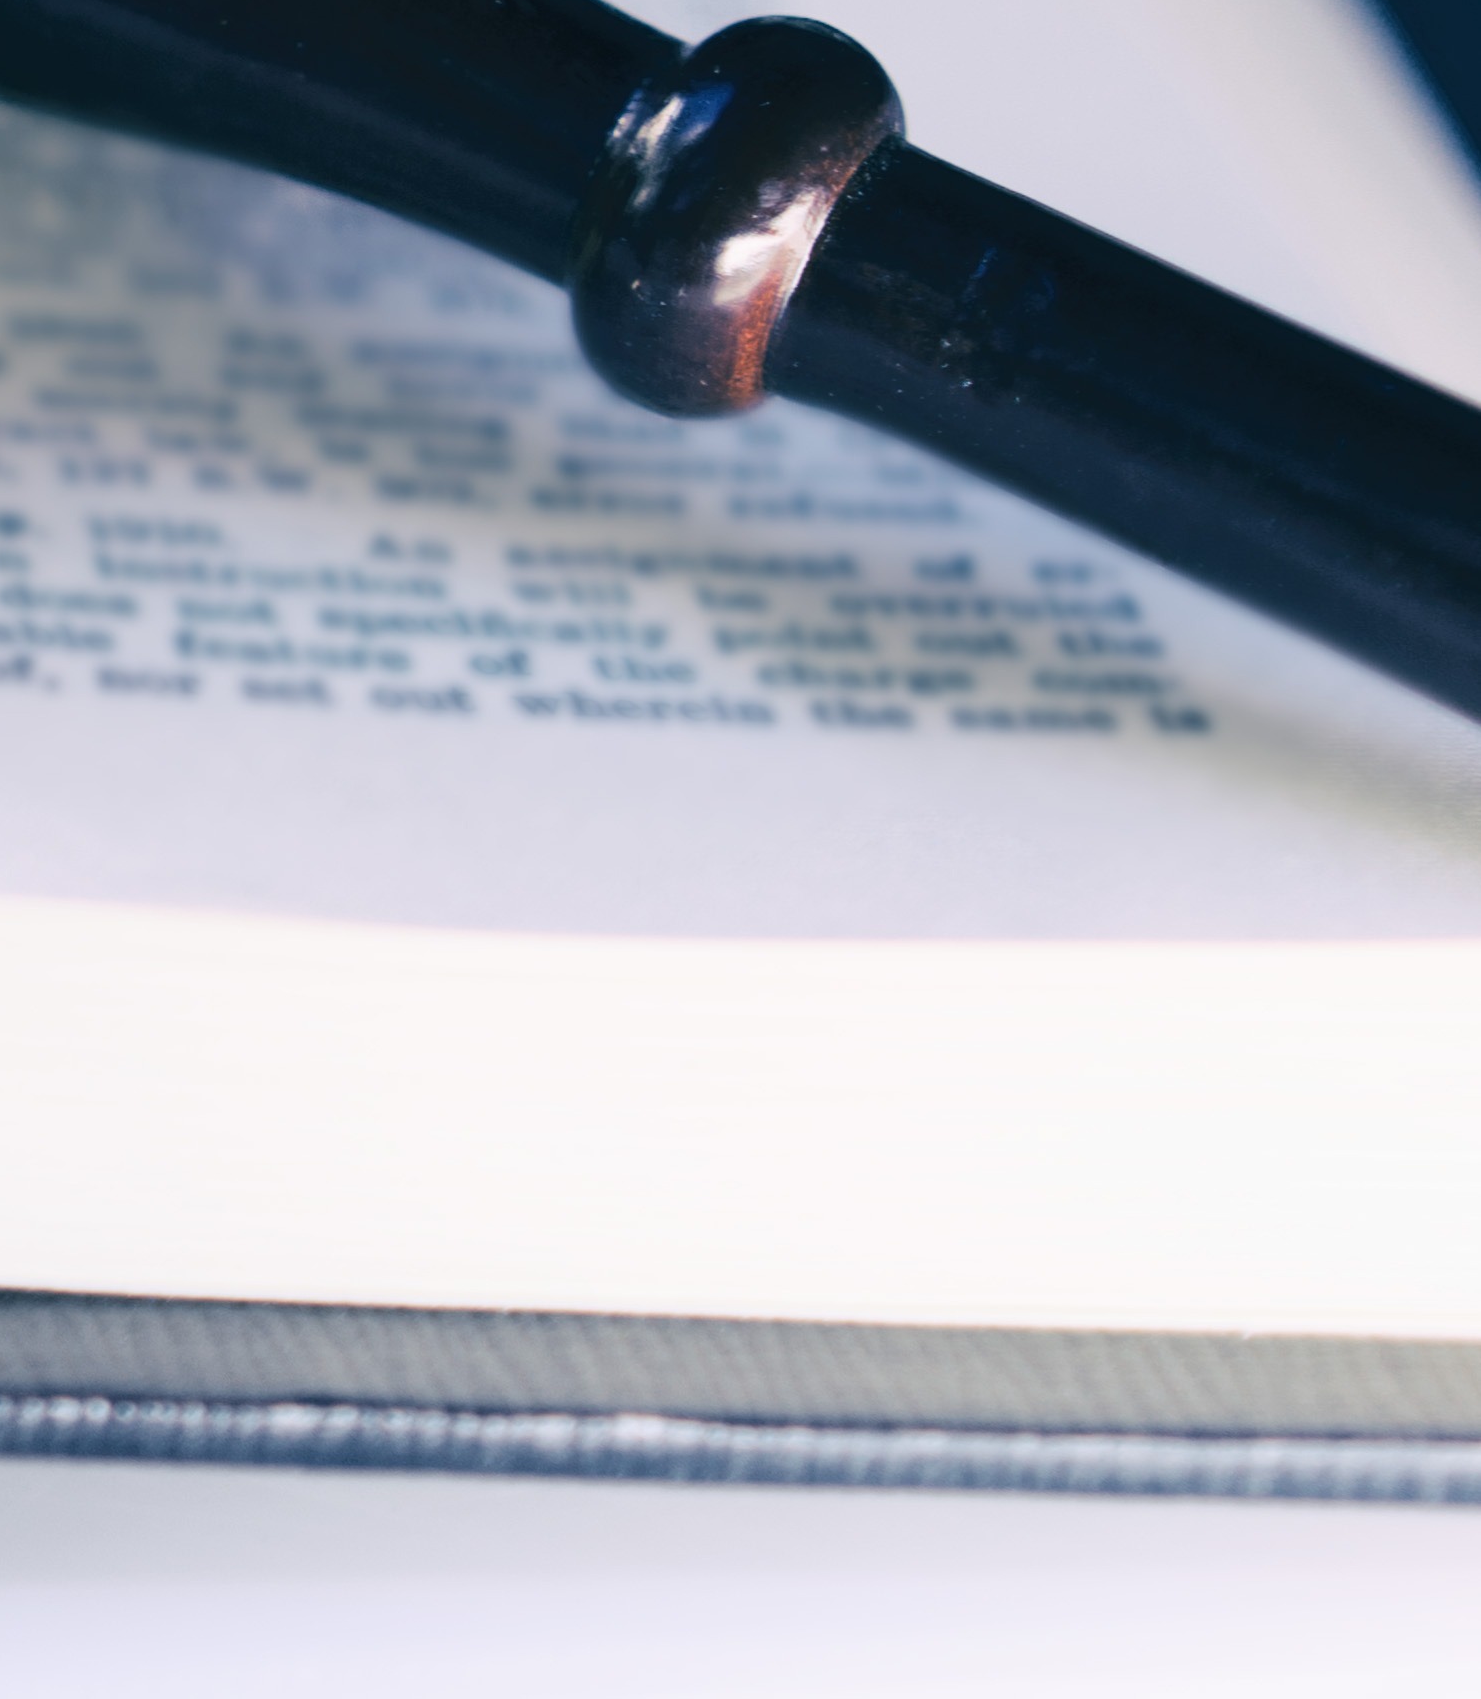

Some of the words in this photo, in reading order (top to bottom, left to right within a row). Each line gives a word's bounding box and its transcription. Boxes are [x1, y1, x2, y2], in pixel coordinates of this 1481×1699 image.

[94, 549, 447, 598] instruction
[511, 580, 632, 608] will
[696, 579, 768, 611] be
[829, 592, 1141, 624] overruled
[368, 532, 453, 564] An
[506, 543, 859, 583] assignment
[912, 550, 975, 583] of
[172, 627, 413, 673] feature
[469, 648, 530, 678] of
[592, 654, 699, 685] the
[755, 660, 975, 699] charge
[175, 597, 275, 627] not
[316, 609, 669, 651] specifically
[713, 622, 873, 656] point
[912, 628, 1023, 659] out
[1057, 629, 1169, 661] the
[96, 667, 200, 697] nor
[241, 677, 331, 708] set
[368, 686, 474, 715] out
[515, 693, 777, 730] wherein
[810, 697, 913, 729] the
[949, 705, 1117, 734] same
[1149, 704, 1213, 736] is
